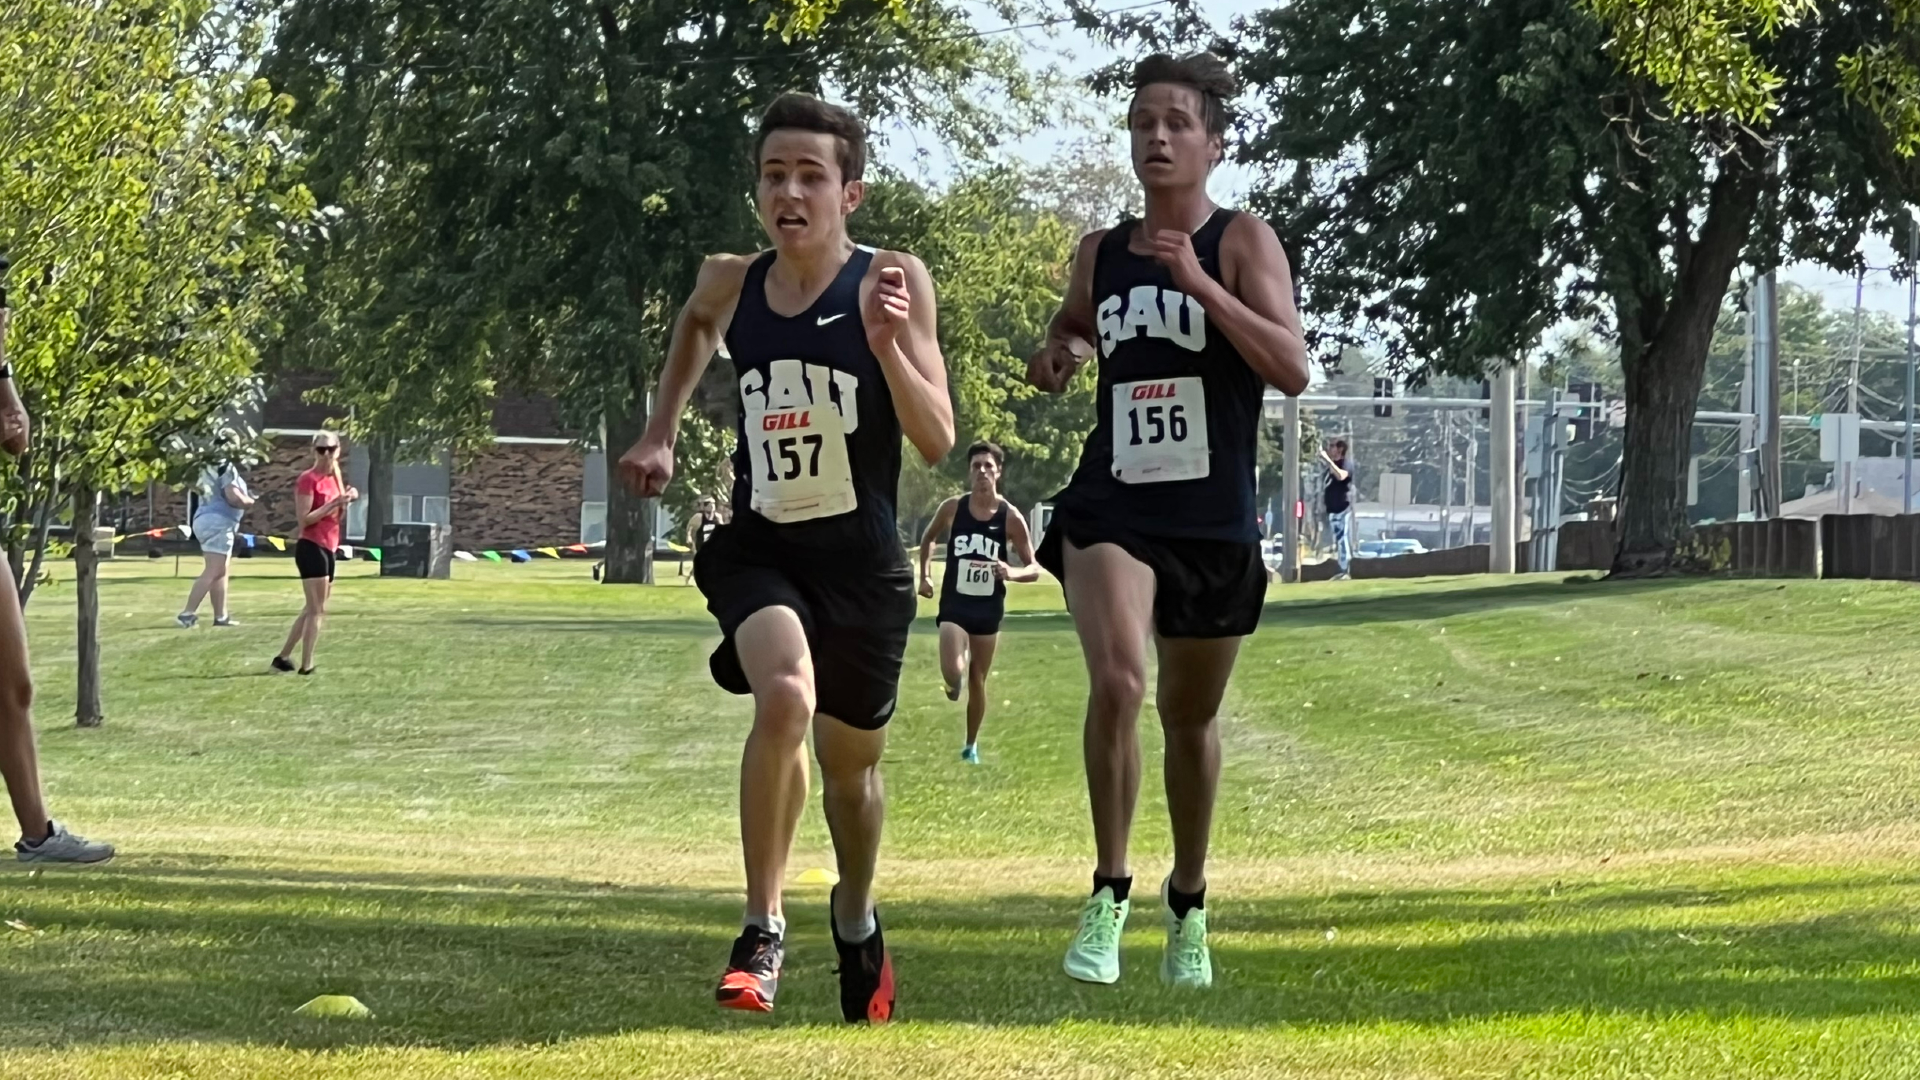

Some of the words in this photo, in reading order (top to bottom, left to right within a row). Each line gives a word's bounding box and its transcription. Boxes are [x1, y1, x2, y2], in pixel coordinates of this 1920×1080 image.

[1097, 285, 1206, 358] SAU
[1131, 383, 1176, 401] GILL
[762, 411, 812, 431] GILL
[1128, 405, 1188, 446] 156
[762, 434, 823, 481] 157
[954, 533, 1001, 561] SAU
